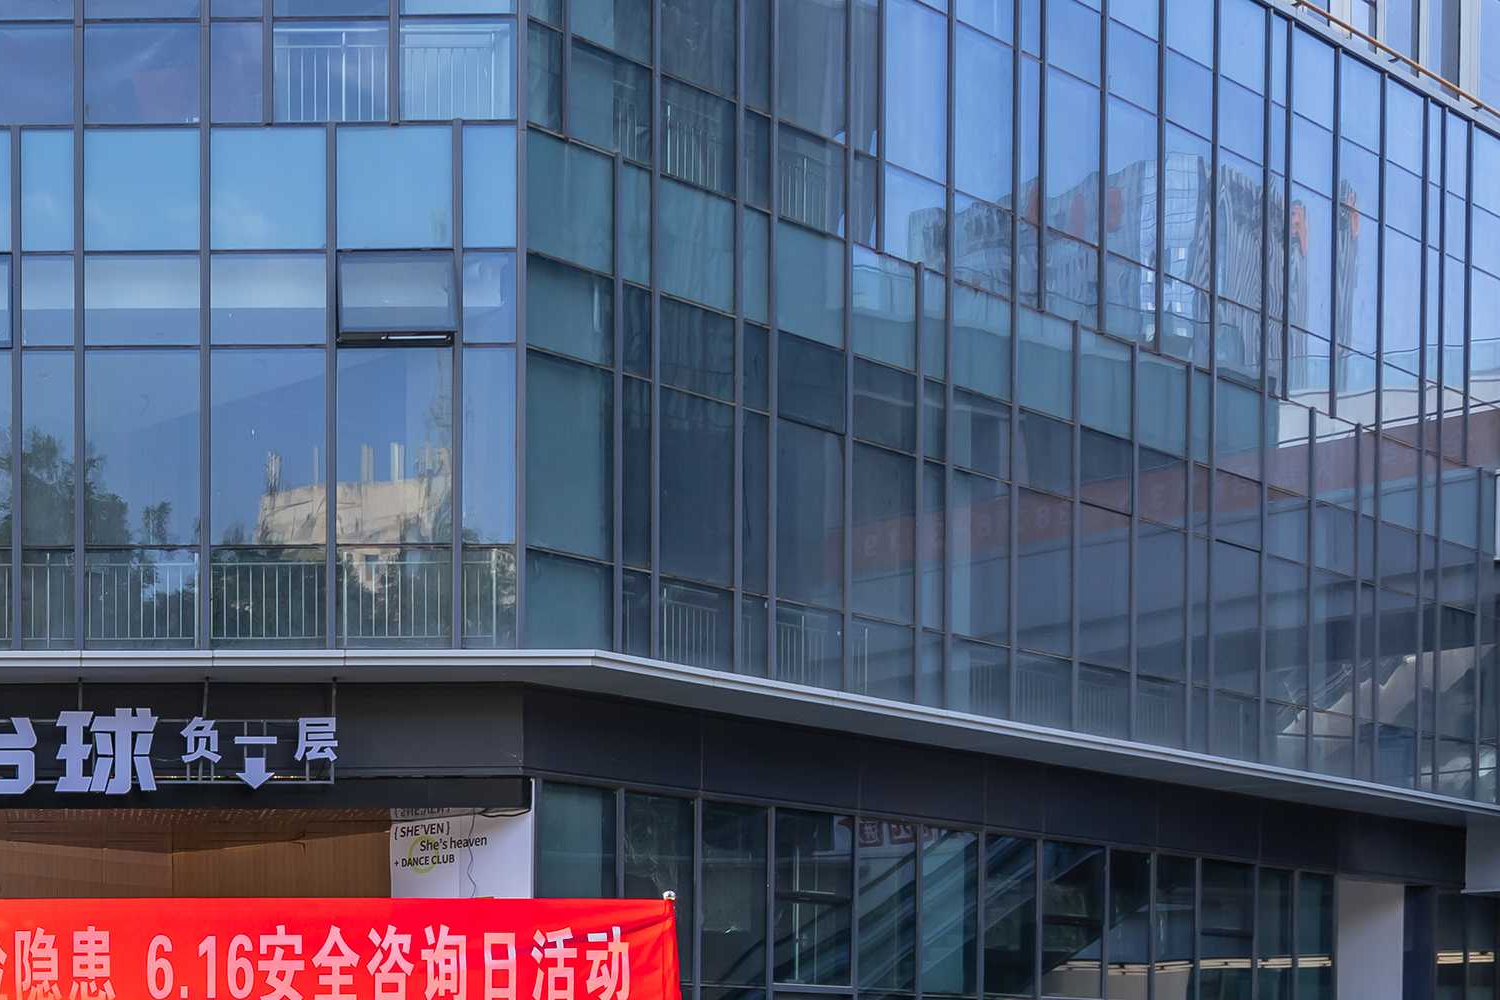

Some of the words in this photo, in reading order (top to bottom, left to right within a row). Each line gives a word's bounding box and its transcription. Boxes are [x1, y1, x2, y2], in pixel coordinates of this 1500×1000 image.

[181, 717, 338, 764] 负一层
[450, 836, 487, 850] heaven
[401, 856, 430, 867] DANCE
[431, 854, 455, 865] CLUB
